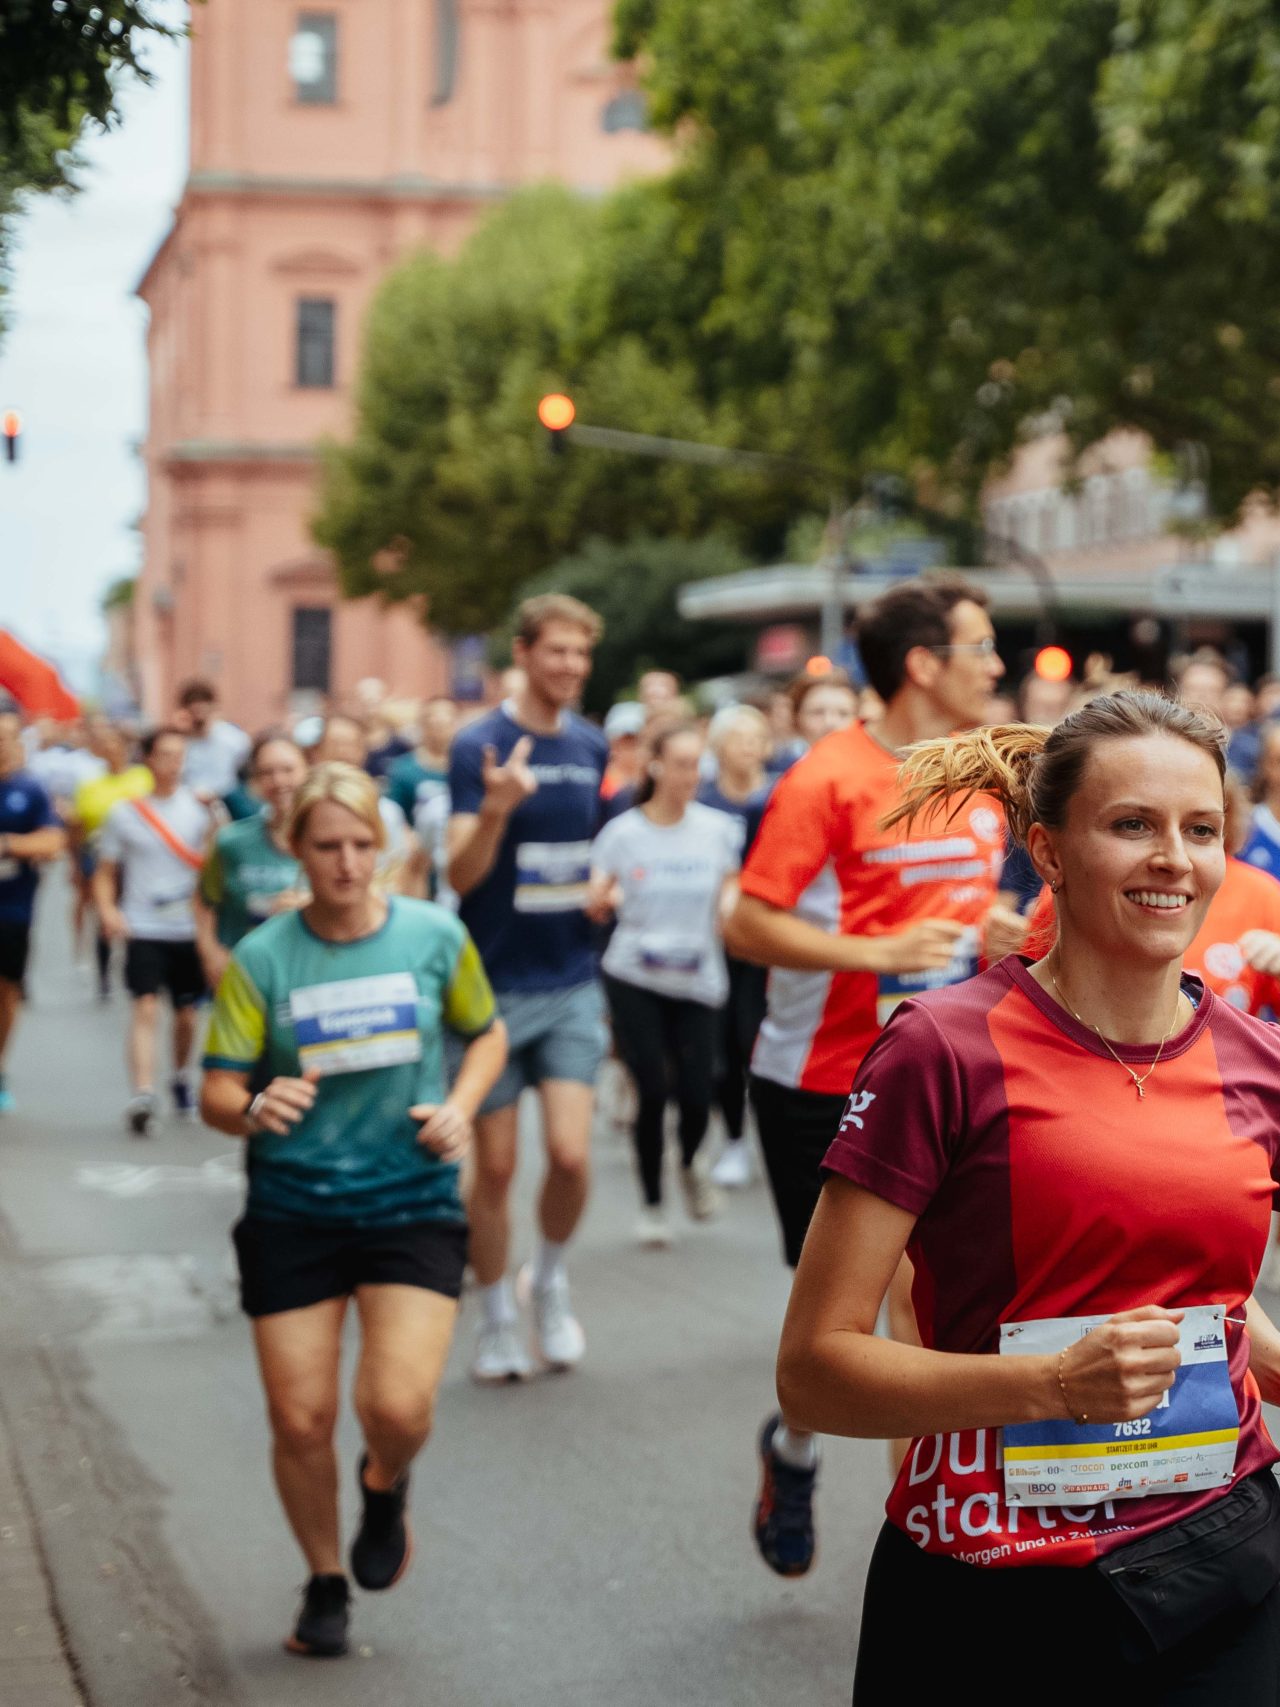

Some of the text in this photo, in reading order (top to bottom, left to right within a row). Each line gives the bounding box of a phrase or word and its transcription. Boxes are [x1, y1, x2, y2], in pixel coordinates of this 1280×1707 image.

[1113, 1418, 1151, 1437] 7632
[1106, 1443, 1133, 1454] STARTZEIT
[1147, 1441, 1158, 1450] UHR
[1031, 1483, 1057, 1493] BDO
[1118, 1477, 1132, 1488] dm
[1015, 1537, 1047, 1553] und
[1050, 1534, 1066, 1544] in
[1069, 1525, 1137, 1540] Zukunft.
